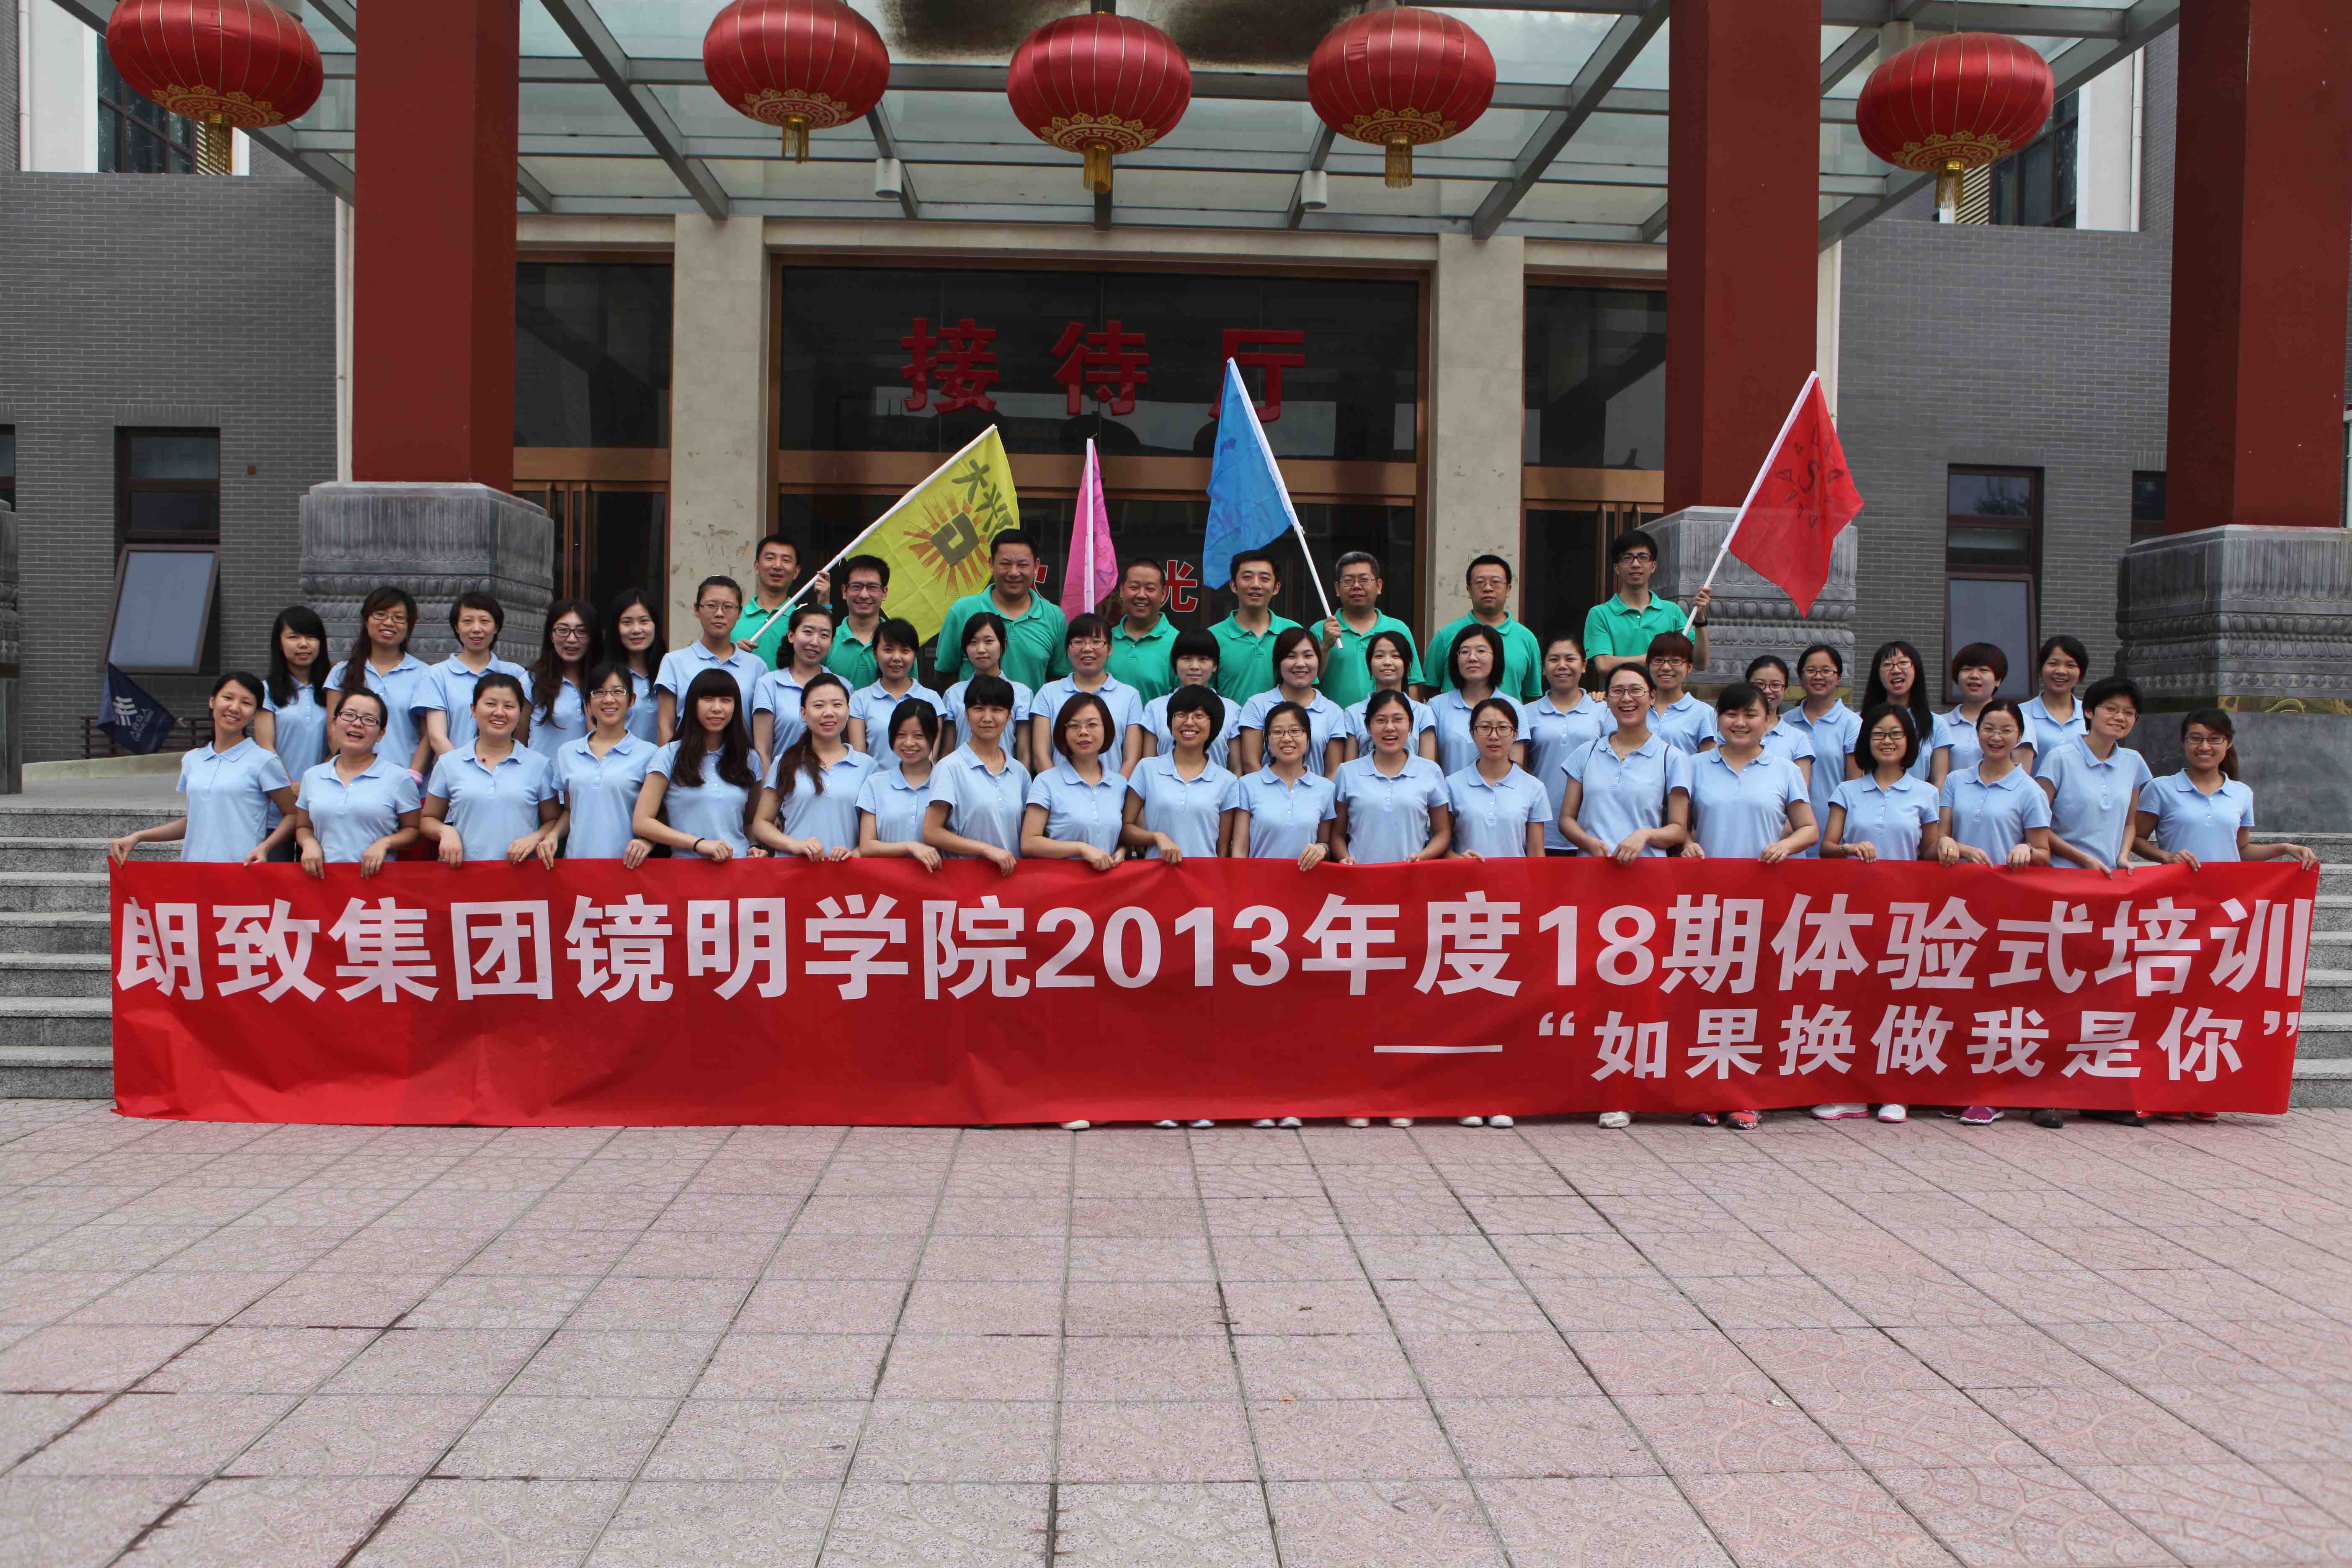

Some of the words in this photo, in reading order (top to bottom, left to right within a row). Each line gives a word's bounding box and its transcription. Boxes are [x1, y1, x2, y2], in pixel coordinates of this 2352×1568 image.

[900, 318, 1305, 423] 接待厅
[116, 890, 2313, 1003] 朗致集团镜明学院2013年度18期体验式培训
